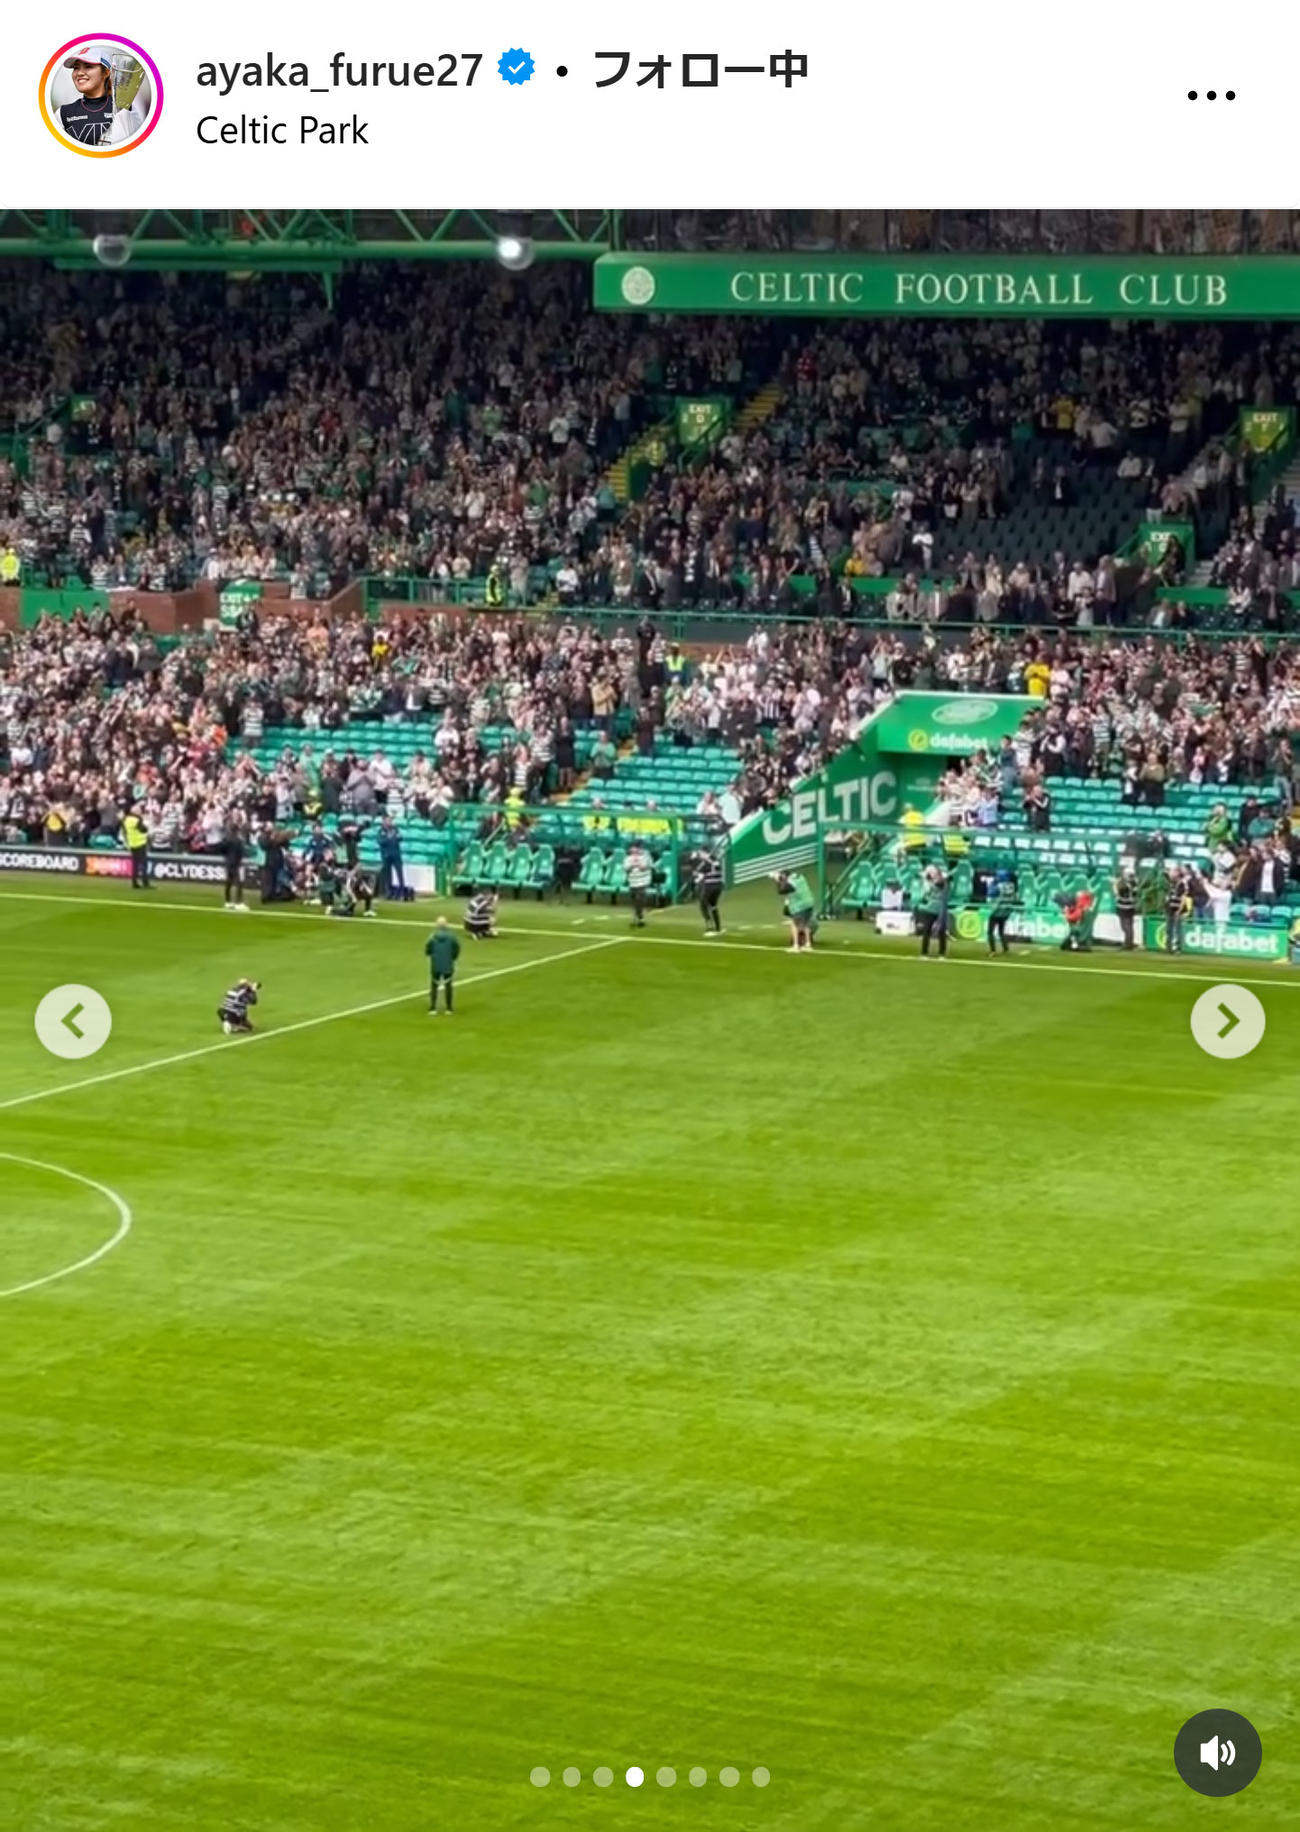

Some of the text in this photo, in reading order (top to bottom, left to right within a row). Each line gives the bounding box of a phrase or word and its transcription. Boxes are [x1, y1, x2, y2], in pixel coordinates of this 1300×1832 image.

[730, 272, 1228, 306] CELTIC FOOTBALL CLUB
[762, 770, 897, 846] CELTIC
[1184, 924, 1279, 954] dafabet
